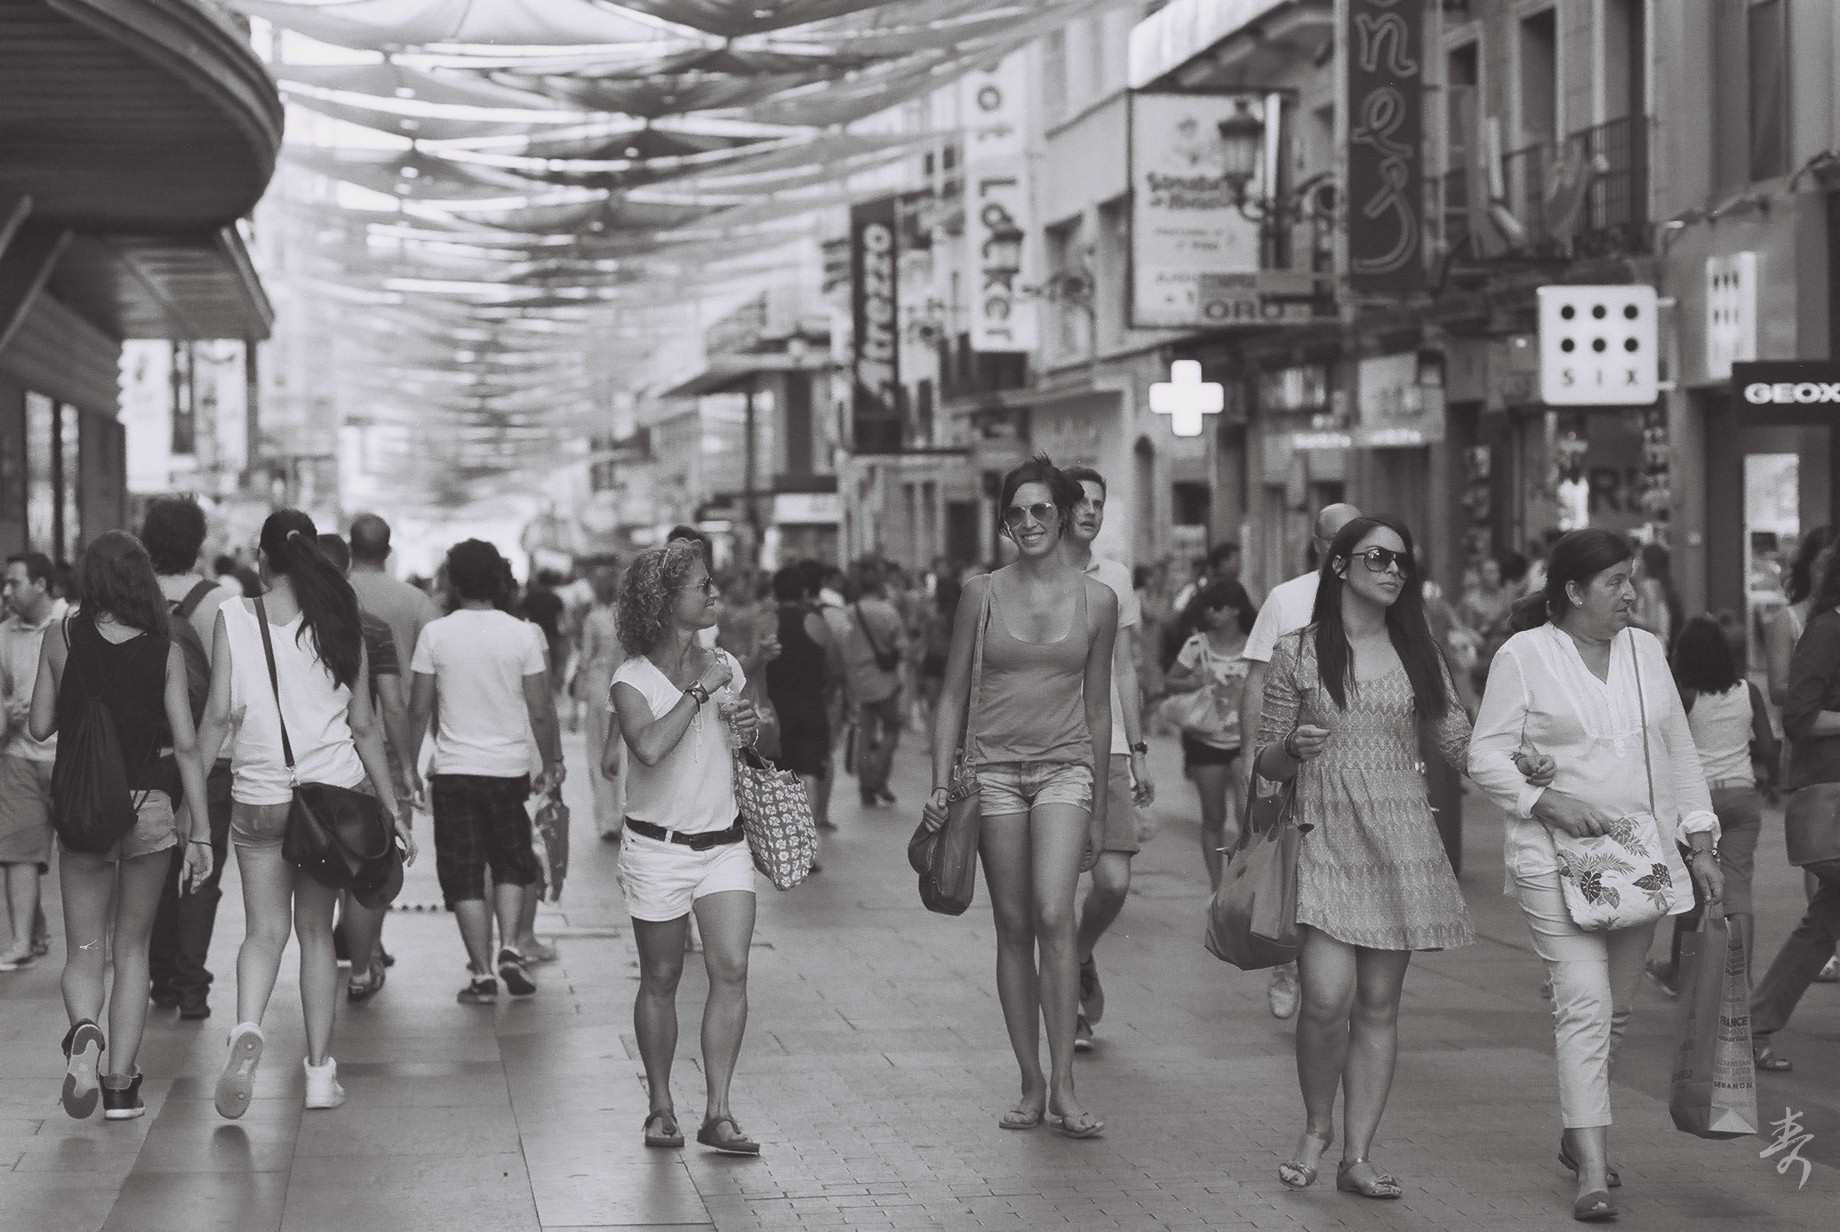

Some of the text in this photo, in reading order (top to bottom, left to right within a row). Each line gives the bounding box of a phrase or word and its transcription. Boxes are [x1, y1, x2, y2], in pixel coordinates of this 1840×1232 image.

[1352, 0, 1418, 274] nez
[1561, 368, 1637, 387] SIX
[1744, 382, 1840, 405] GEOX
[1720, 1014, 1748, 1028] FRANCE
[1713, 1080, 1753, 1090] LEBANON
